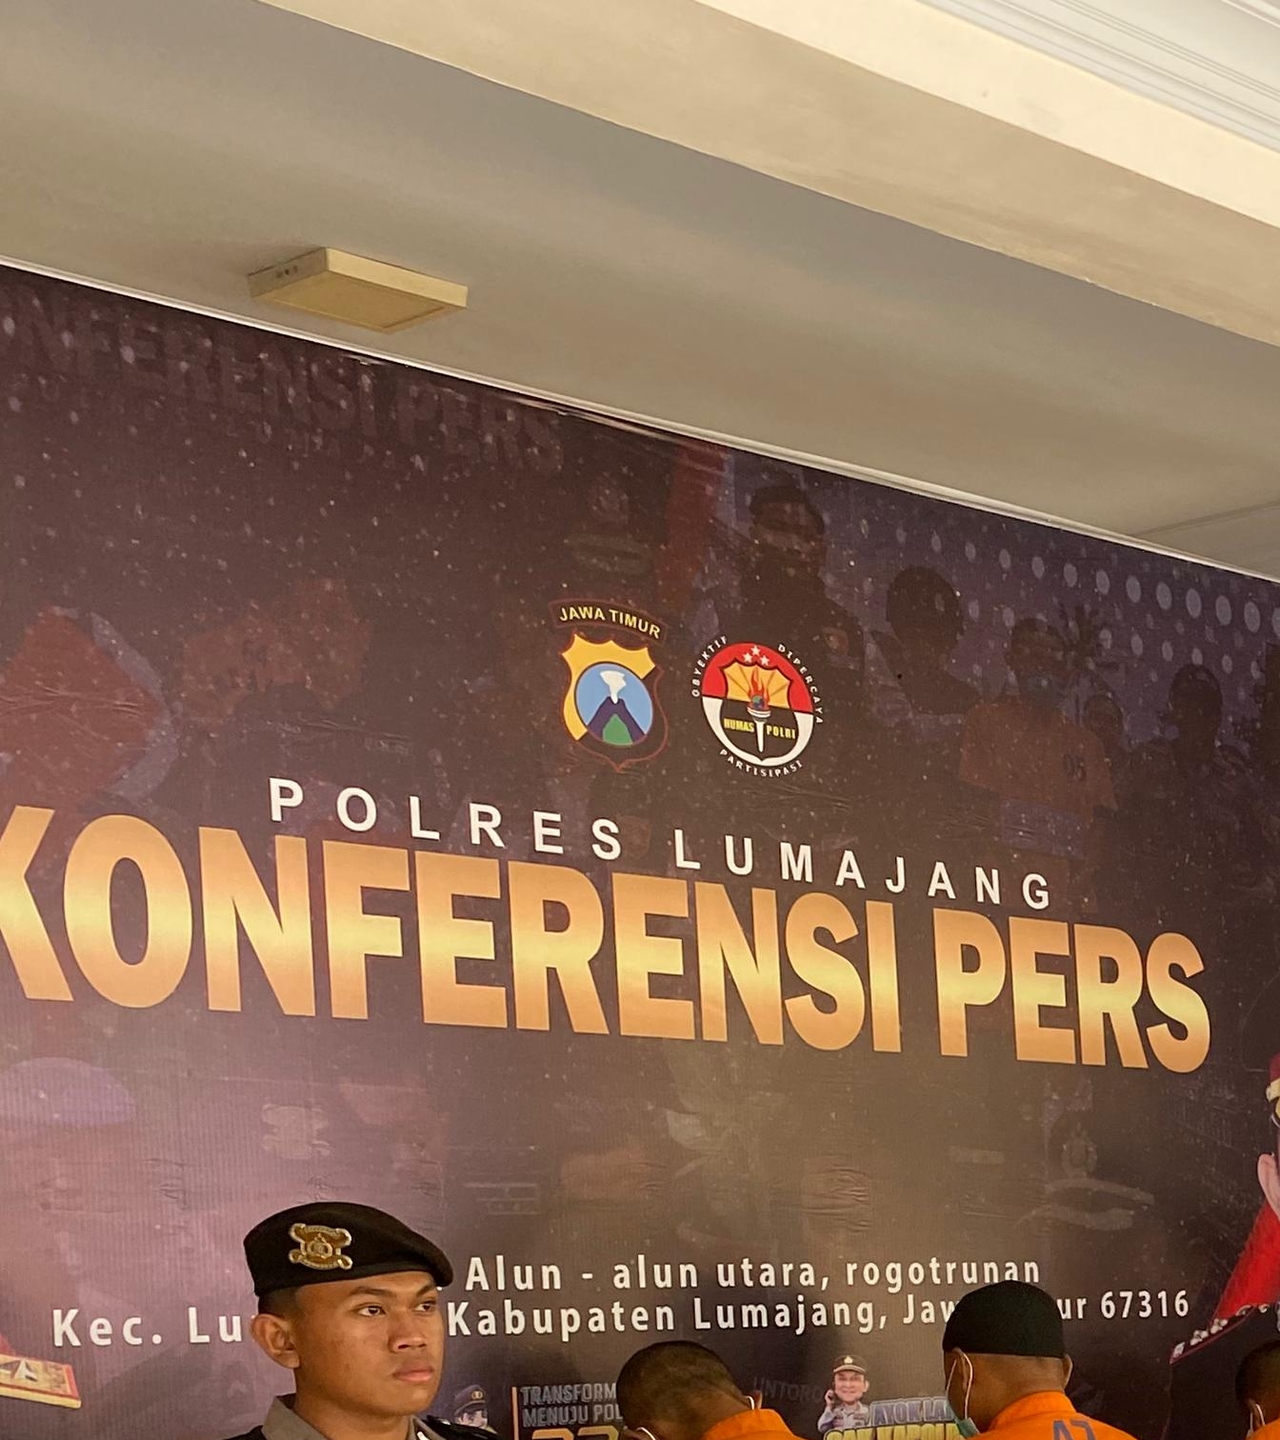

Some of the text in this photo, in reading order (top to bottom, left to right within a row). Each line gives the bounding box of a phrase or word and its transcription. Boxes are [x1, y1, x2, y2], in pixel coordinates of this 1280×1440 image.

[560, 606, 661, 639] JAWA TIMUR
[692, 636, 727, 697] OBYEKTIF
[778, 644, 823, 724] DIPERCAYA
[766, 724, 796, 739] POLRI
[719, 748, 802, 777] PARTISIPASI
[271, 778, 1050, 910] POLRES LUMAJANG
[933, 909, 1211, 1074] PERS
[465, 1254, 561, 1291] Alun
[613, 1254, 698, 1289] alun
[717, 1257, 829, 1291] utara,
[847, 1257, 1039, 1293] rogotrunan
[52, 1308, 162, 1347] Kec.
[447, 1298, 674, 1342] Kabupaten
[694, 1294, 887, 1336] Lumajang,
[902, 1293, 956, 1325] Jaw
[1100, 1289, 1190, 1319] 67316
[520, 1382, 618, 1405] TRANSFORM
[522, 1403, 623, 1427] MENUJU POL
